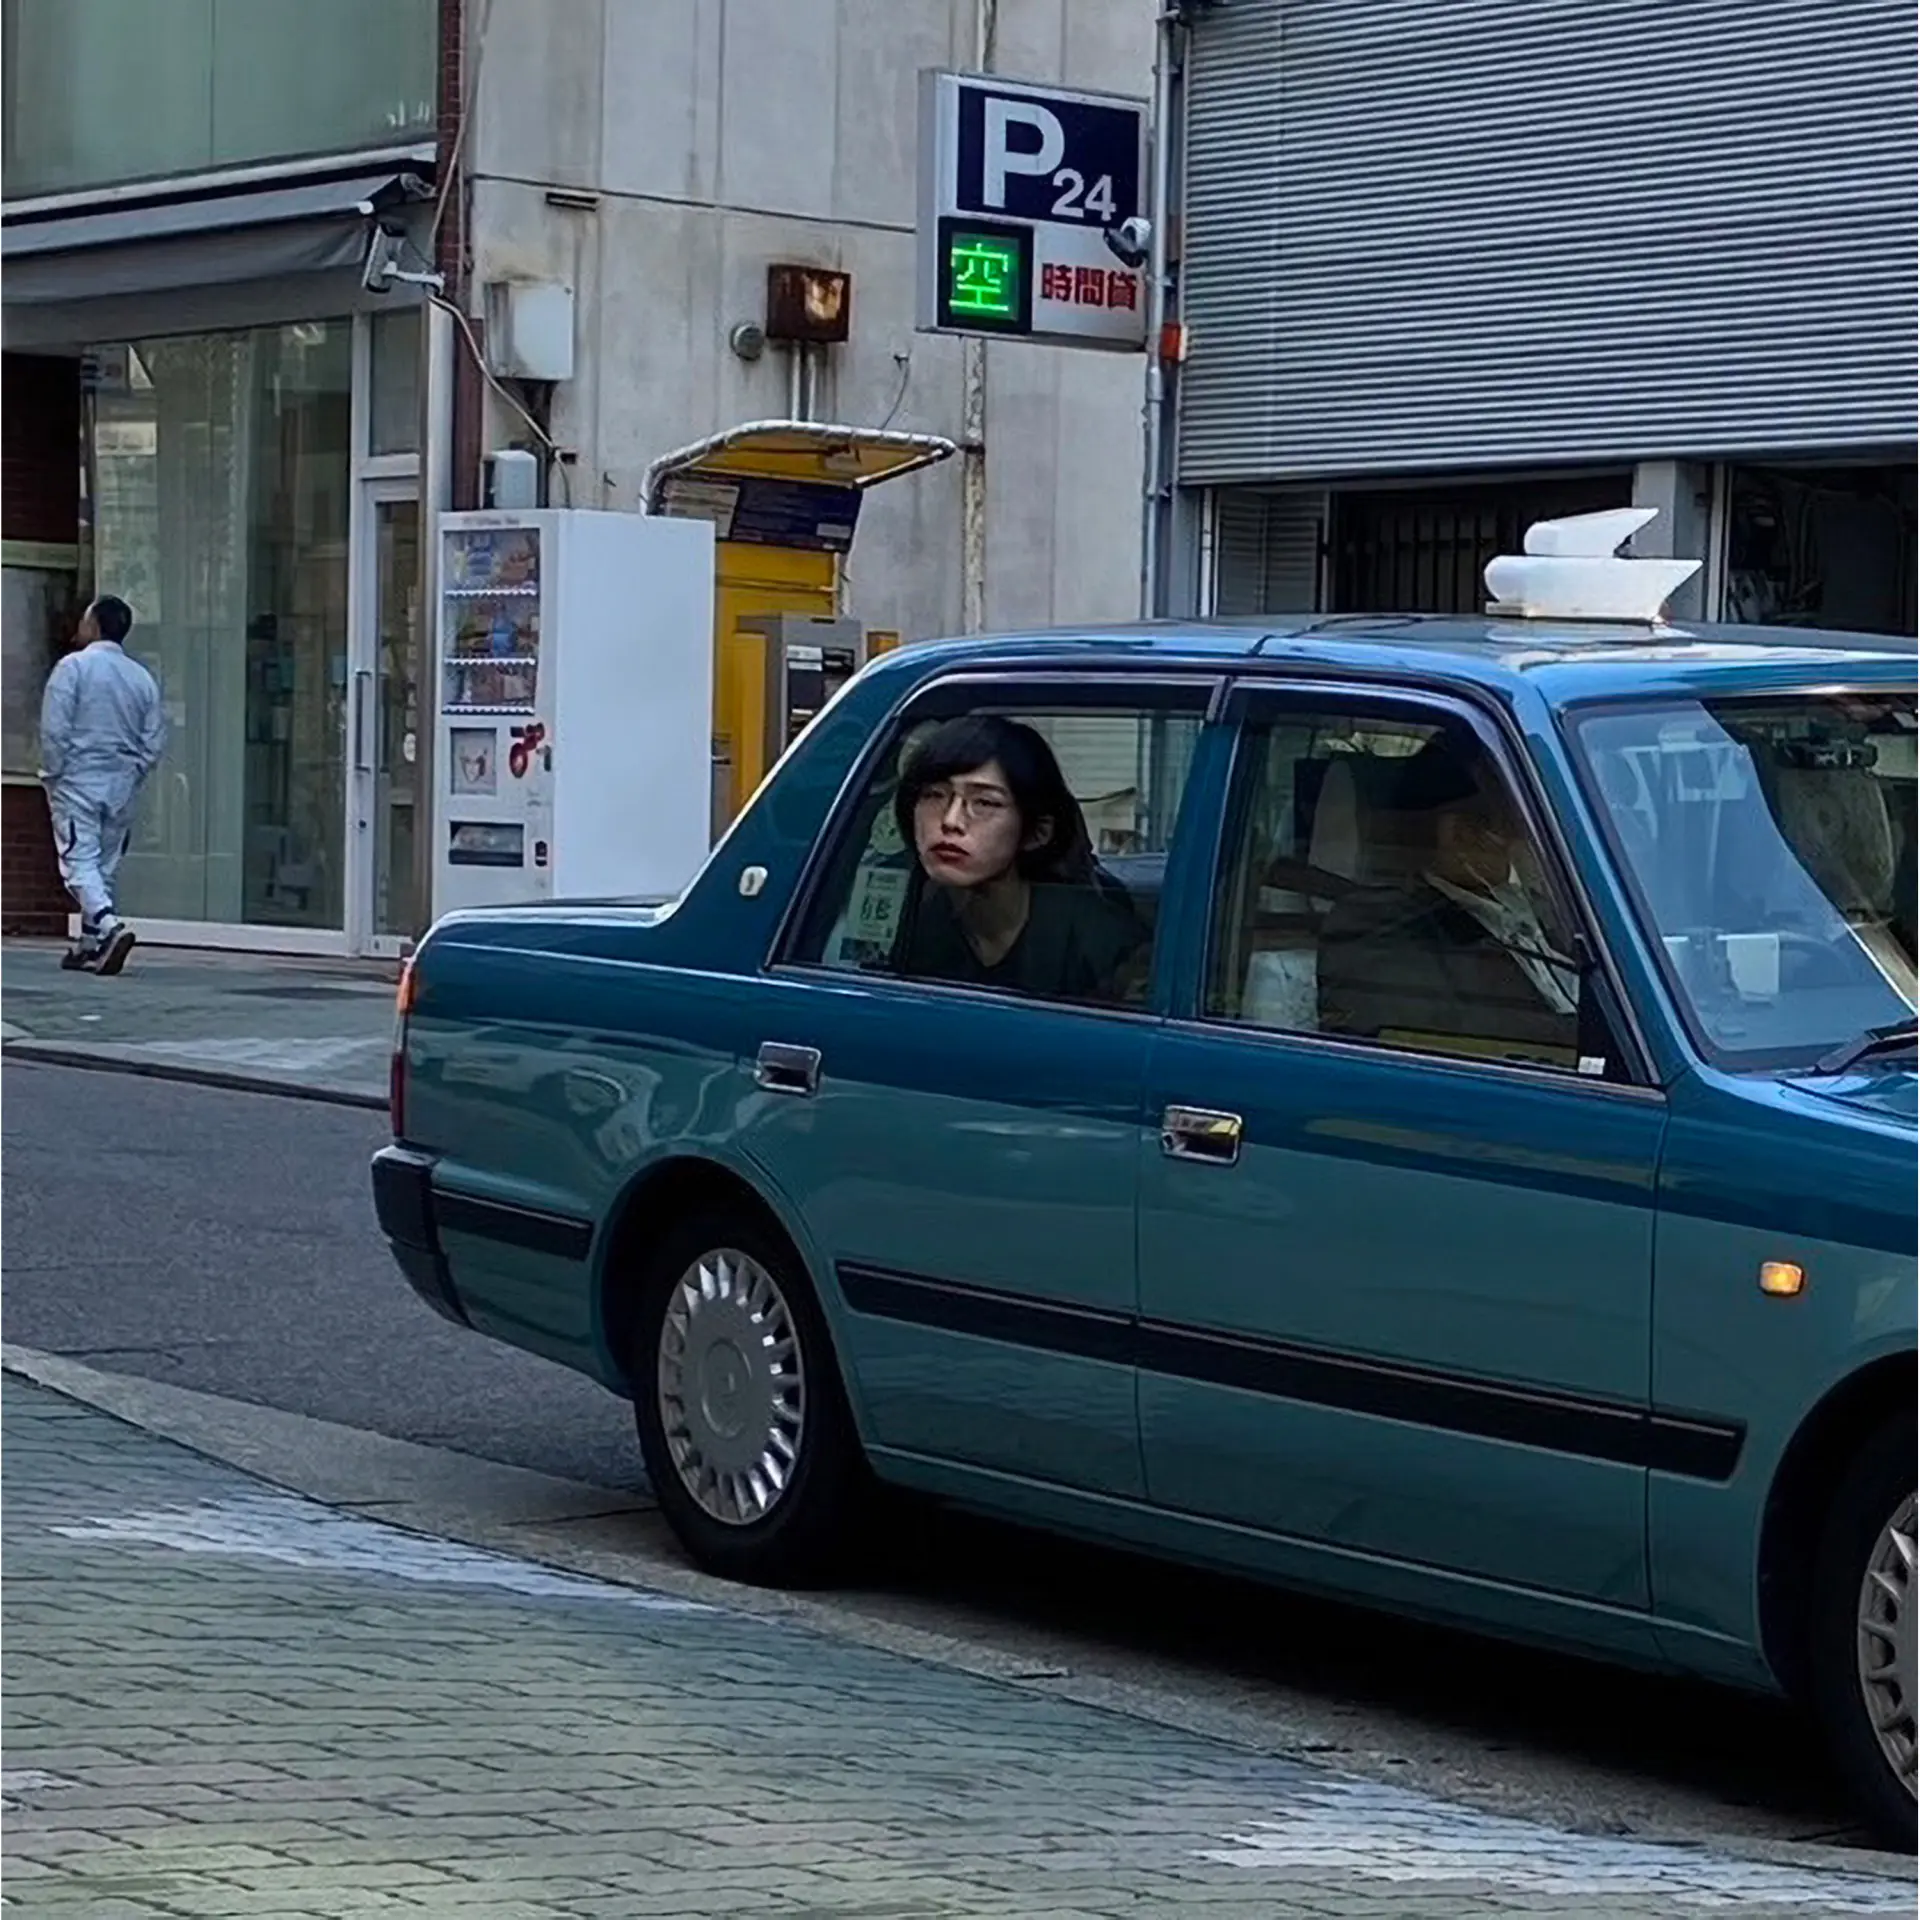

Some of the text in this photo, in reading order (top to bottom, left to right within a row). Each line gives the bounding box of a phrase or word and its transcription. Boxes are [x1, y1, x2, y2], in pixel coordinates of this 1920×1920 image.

[949, 242, 1010, 312] 空
[1041, 262, 1138, 312] 時間貸
